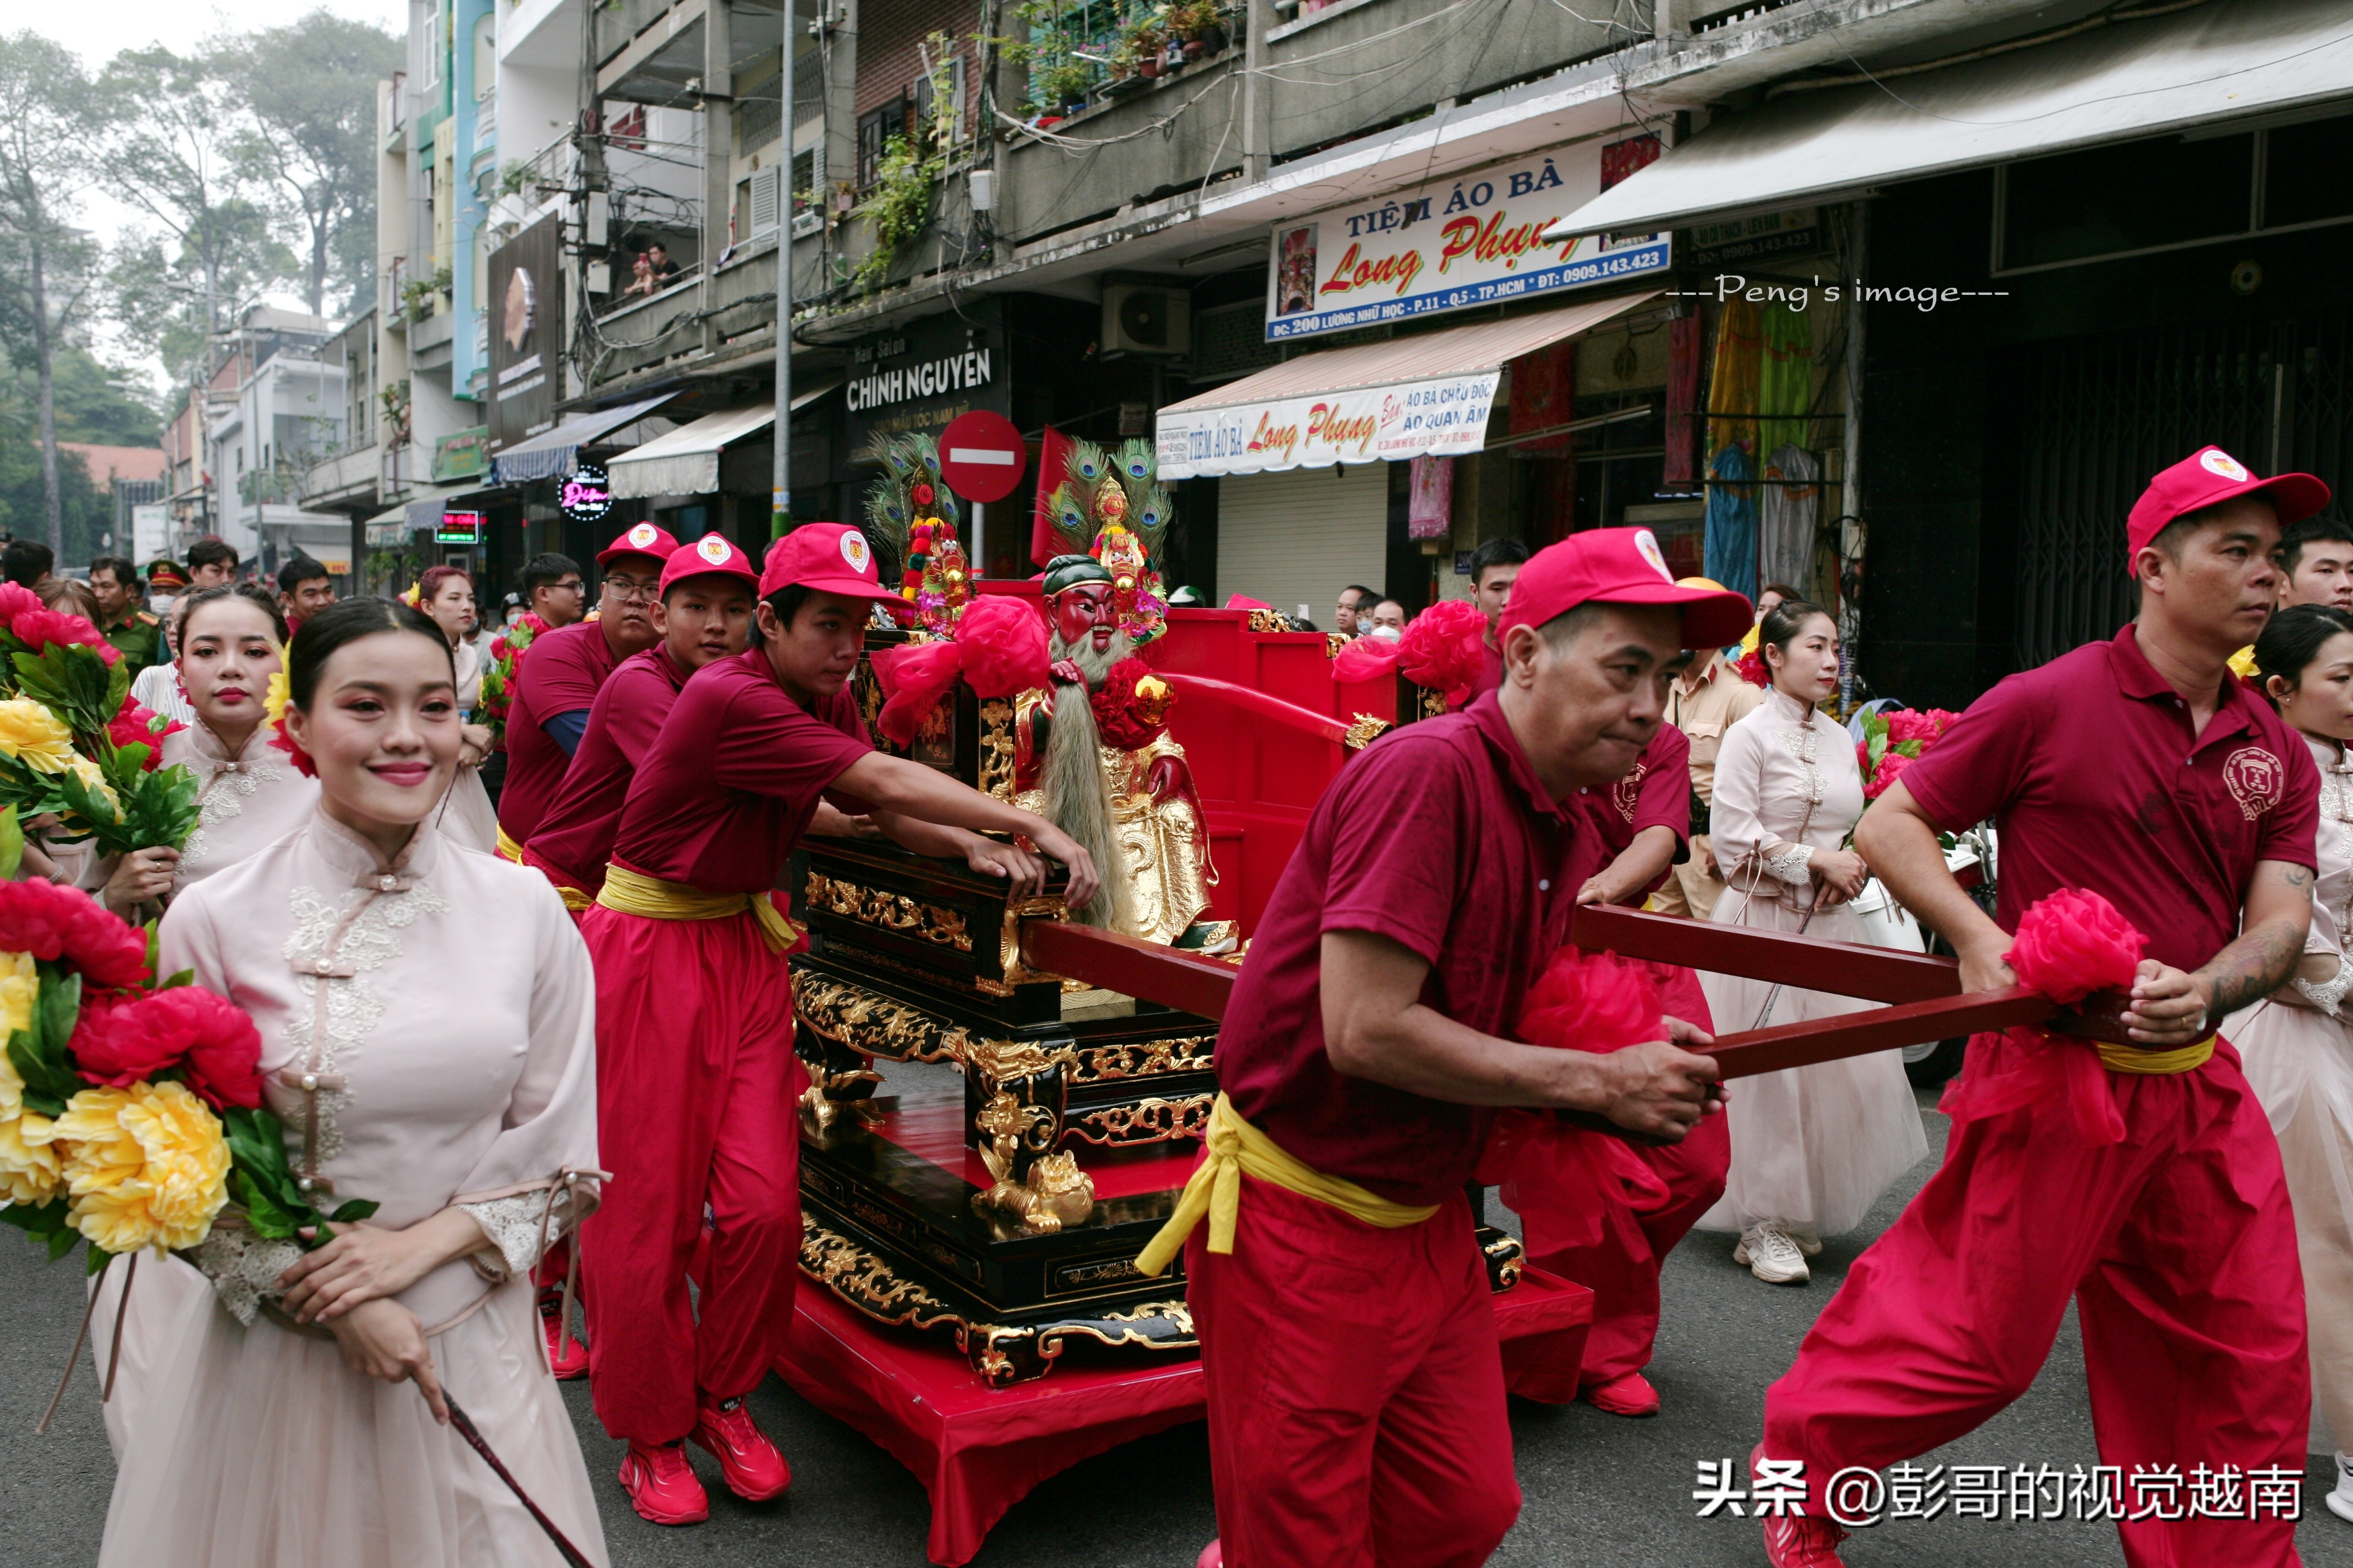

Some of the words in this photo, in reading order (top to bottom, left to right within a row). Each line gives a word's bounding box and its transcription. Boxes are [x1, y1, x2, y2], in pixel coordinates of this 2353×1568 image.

[1345, 197, 1433, 237] TIỆM
[1443, 182, 1494, 215] ÁO
[1508, 158, 1564, 198] BÀ
[1319, 242, 1424, 296] Long
[1722, 232, 1811, 260] 0909.143.423
[1274, 325, 1290, 337] ĐC:
[1291, 317, 1320, 333] 200
[1322, 311, 1355, 329] LƯƠNG
[1357, 304, 1380, 323] NHỮ
[1382, 303, 1405, 319] HỌC
[1414, 297, 1439, 312] P.11
[1449, 291, 1468, 307] Q.5
[1478, 279, 1525, 300] TP.HCM
[1538, 273, 1560, 288] ĐT:
[1563, 251, 1660, 284] 0909.143.423
[847, 363, 902, 411] CHÍNH
[906, 330, 990, 400] NGUYỄN
[855, 344, 873, 364] Hair
[877, 338, 906, 359] Salon
[913, 407, 931, 428] TÓC
[933, 408, 953, 425] NAM
[1403, 412, 1422, 431] ÁO
[1425, 411, 1462, 430] QUAN
[1466, 405, 1487, 424] ÂM
[1406, 389, 1421, 408] ÁO
[1423, 386, 1436, 406] BÀ
[1441, 383, 1468, 403] CHÂU
[1471, 380, 1492, 400] ĐỐC
[1189, 423, 1212, 466] TIỆM
[1214, 419, 1228, 458] ÁO
[1230, 417, 1243, 456] BÀ
[1246, 410, 1298, 463] Long
[1304, 402, 1376, 456] Phụng
